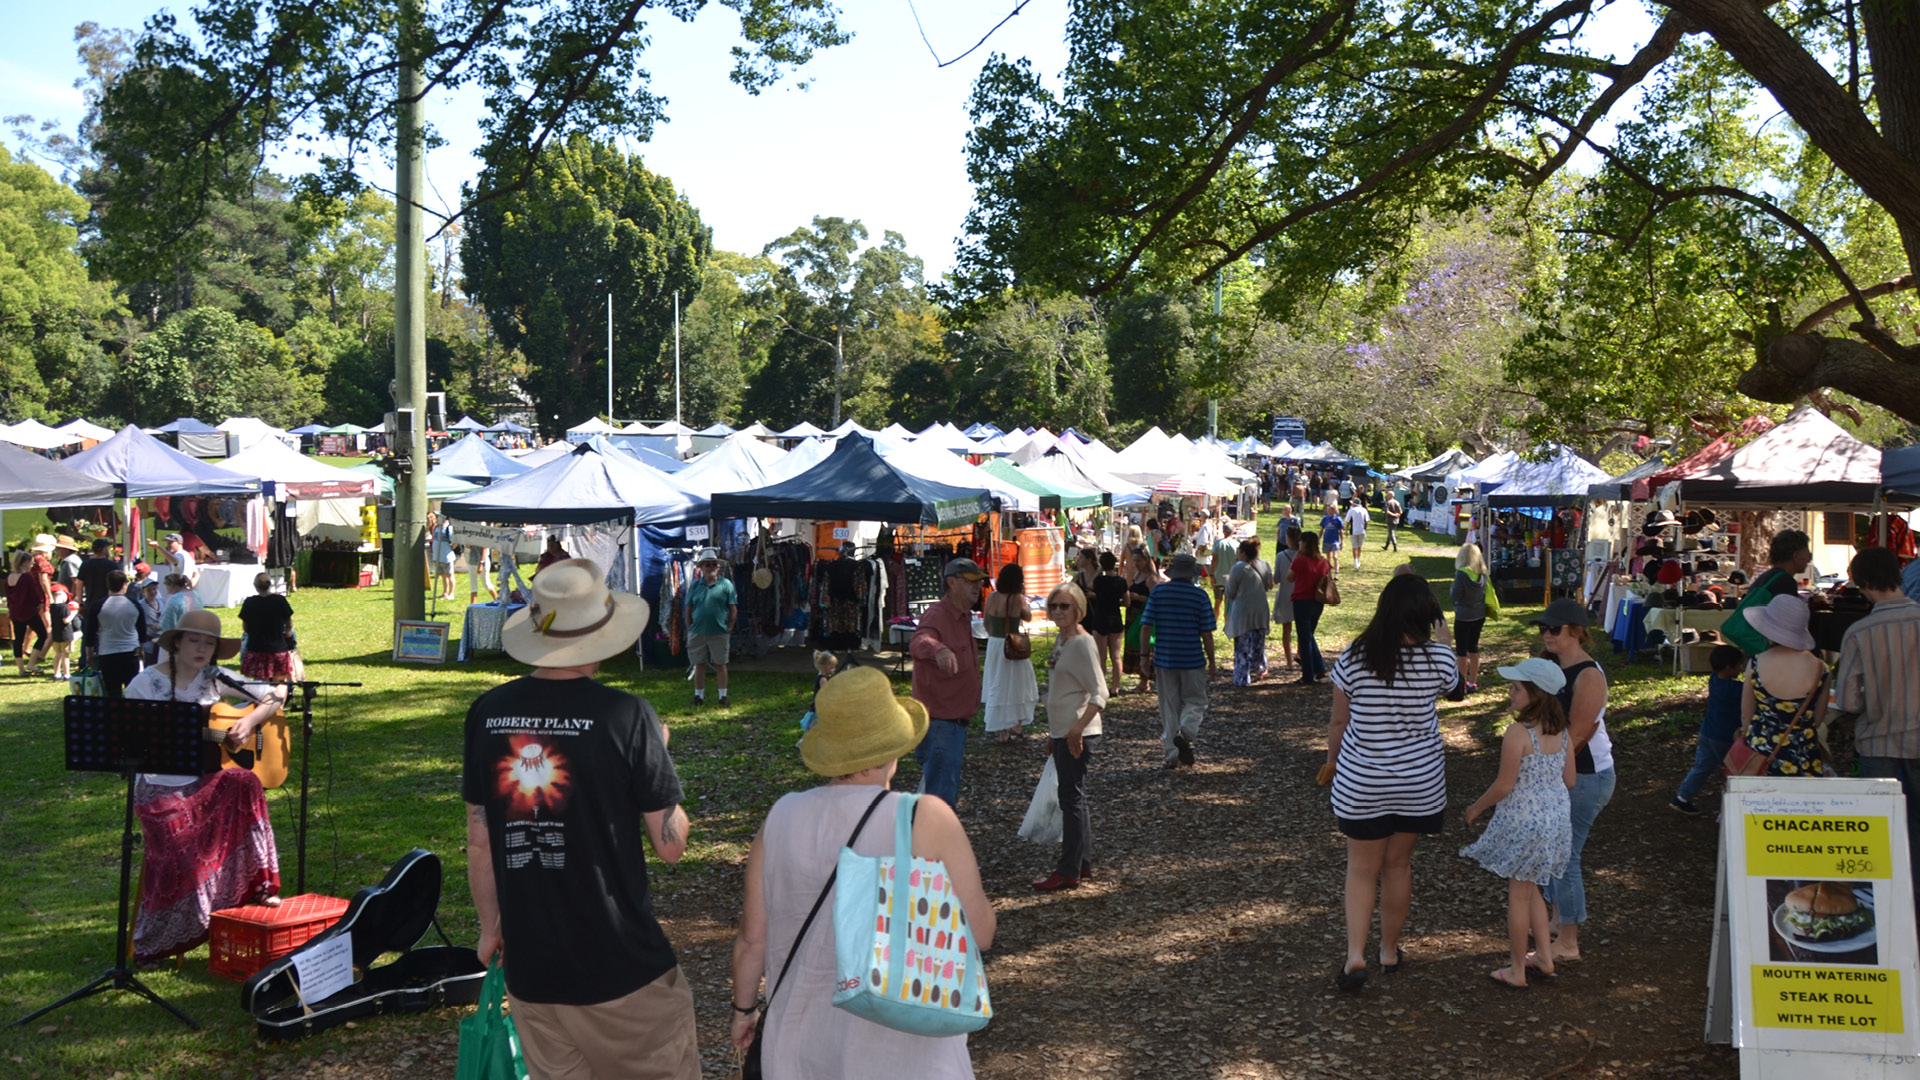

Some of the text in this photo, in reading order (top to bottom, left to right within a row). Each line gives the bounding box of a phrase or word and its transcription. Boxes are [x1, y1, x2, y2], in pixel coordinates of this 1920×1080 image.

[688, 527, 706, 536] $30
[834, 528, 850, 538] $30
[485, 717, 594, 730] ROBERT PLANT
[1763, 819, 1870, 832] CHACARERO
[1766, 844, 1869, 855] CHILEAN STYLE
[1762, 969, 1887, 982] MOUTH WATERING
[1780, 991, 1873, 1005] STEAK ROLL
[1777, 1013, 1877, 1026] WITH THE LOT
